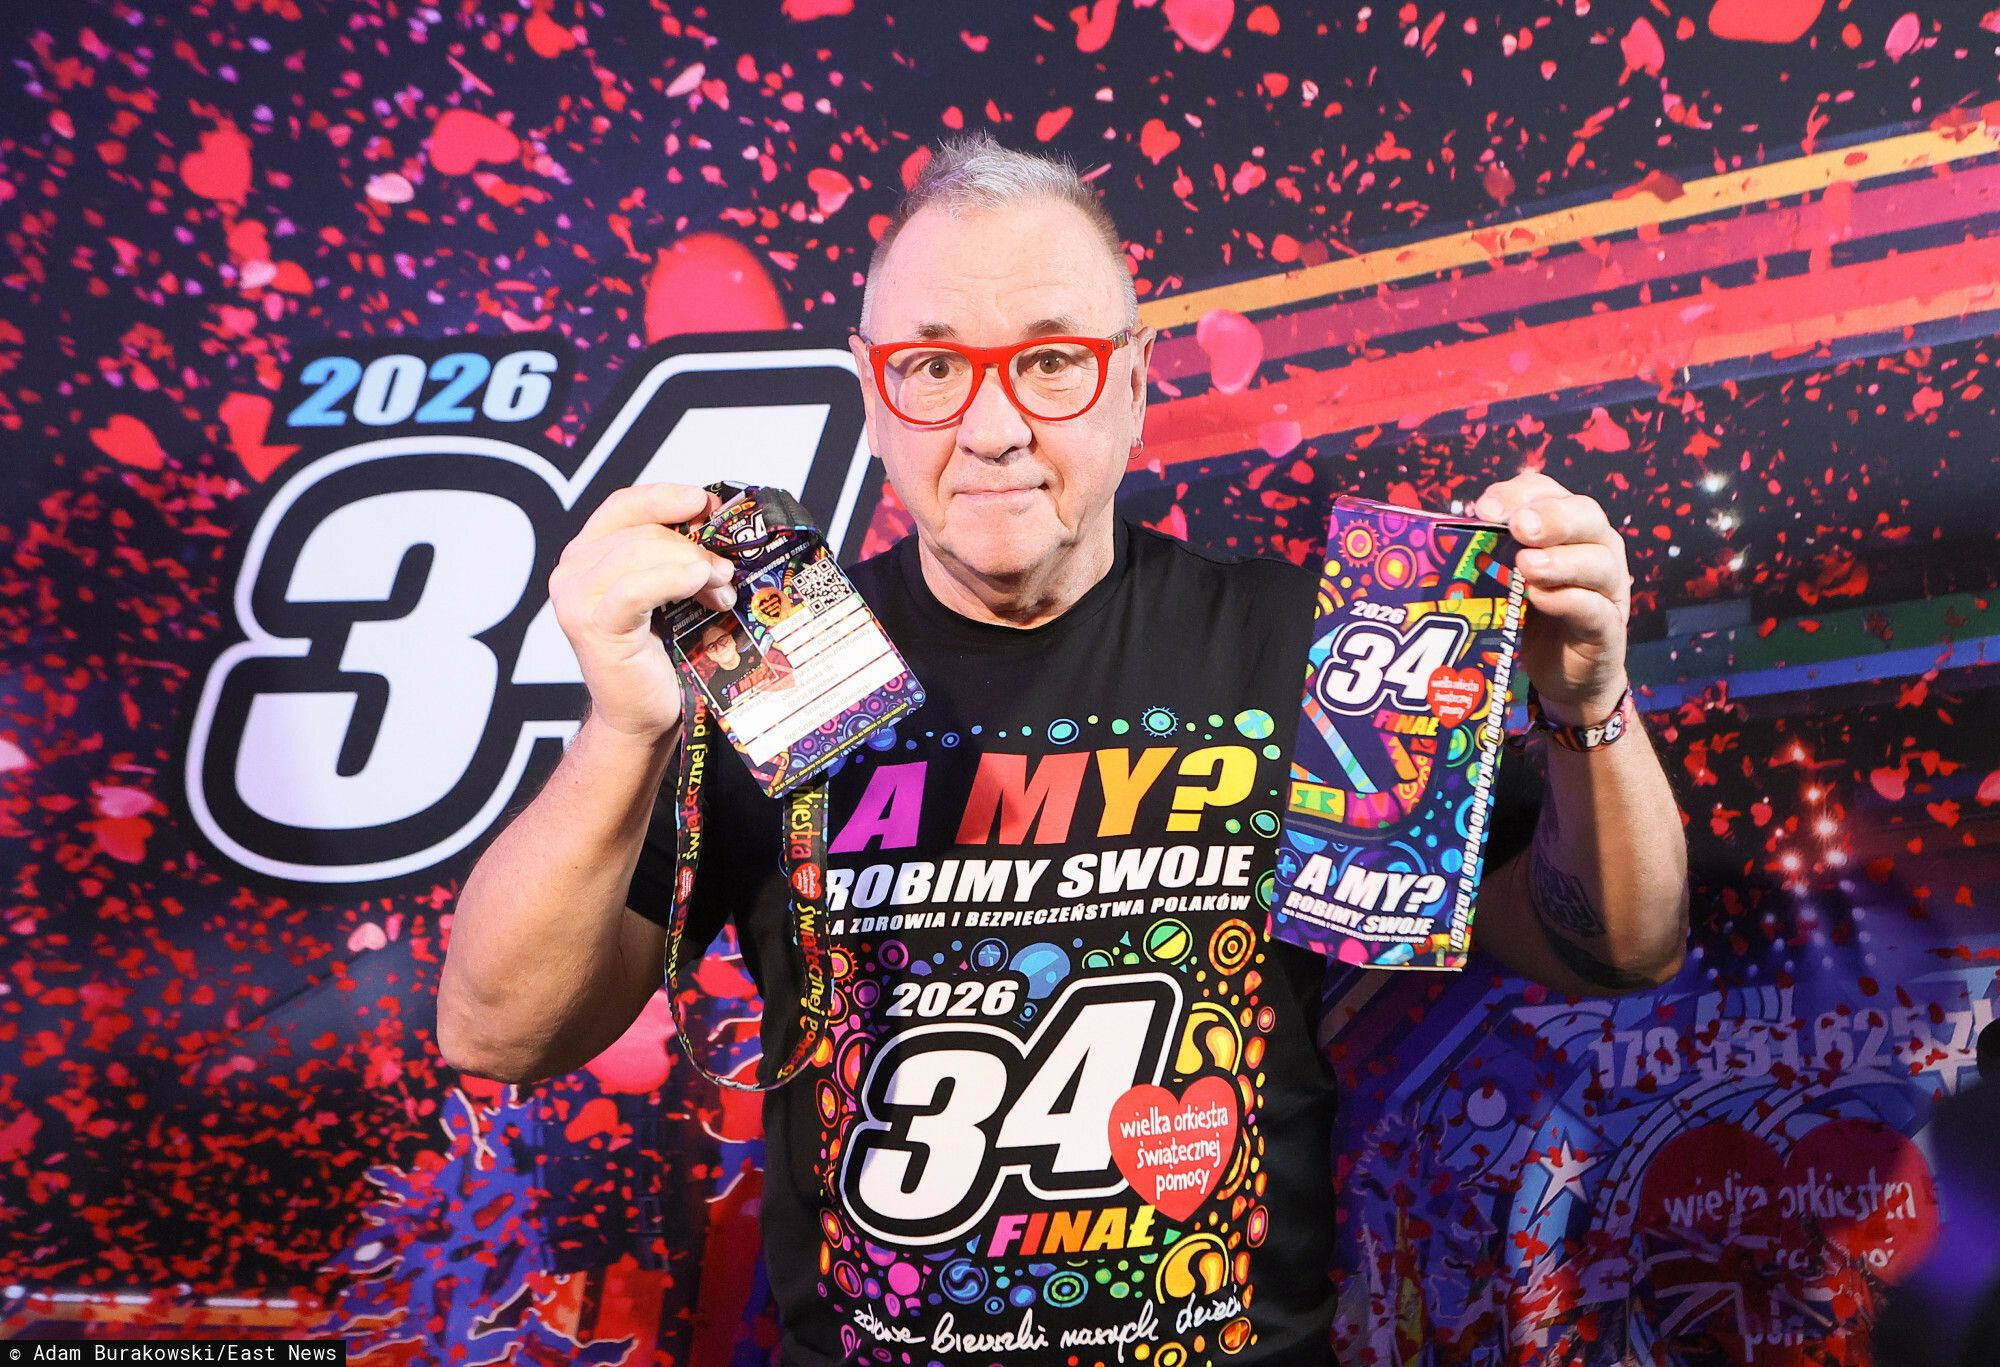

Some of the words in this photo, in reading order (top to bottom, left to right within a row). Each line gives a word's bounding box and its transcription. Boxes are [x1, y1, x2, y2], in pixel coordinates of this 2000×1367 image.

[287, 349, 559, 427] 2026
[232, 404, 831, 830] 34
[1350, 600, 1407, 625] 2026
[1325, 627, 1459, 705] 34
[1486, 641, 1515, 740] PRZEWODU
[790, 784, 824, 860] rkiestra
[829, 760, 928, 854] A
[954, 745, 1257, 846] MY?
[1462, 739, 1498, 877] POKARMOWEGO
[827, 858, 1051, 911] ROBIMY
[1057, 845, 1255, 899] SWOJE
[1293, 853, 1333, 896] A
[1333, 864, 1447, 914] MY?
[1458, 876, 1474, 894] U
[850, 912, 945, 936] ZDROWIA
[951, 912, 959, 928] I
[965, 899, 1145, 929] BEZPIECZEŃSTWA
[1150, 893, 1251, 914] POLAKÓW
[1285, 890, 1366, 930] ROBIMY
[1362, 914, 1435, 937] SWOJE
[1450, 893, 1471, 949] DZIECI
[891, 979, 1020, 1018] 2026
[859, 1000, 1151, 1223] 34
[1120, 1105, 1171, 1139] wielka
[1174, 1100, 1229, 1132] orkiestra
[1136, 1132, 1221, 1170] świątecznej
[1155, 1168, 1211, 1201] pomocy
[987, 1204, 1156, 1258] FINAŁ
